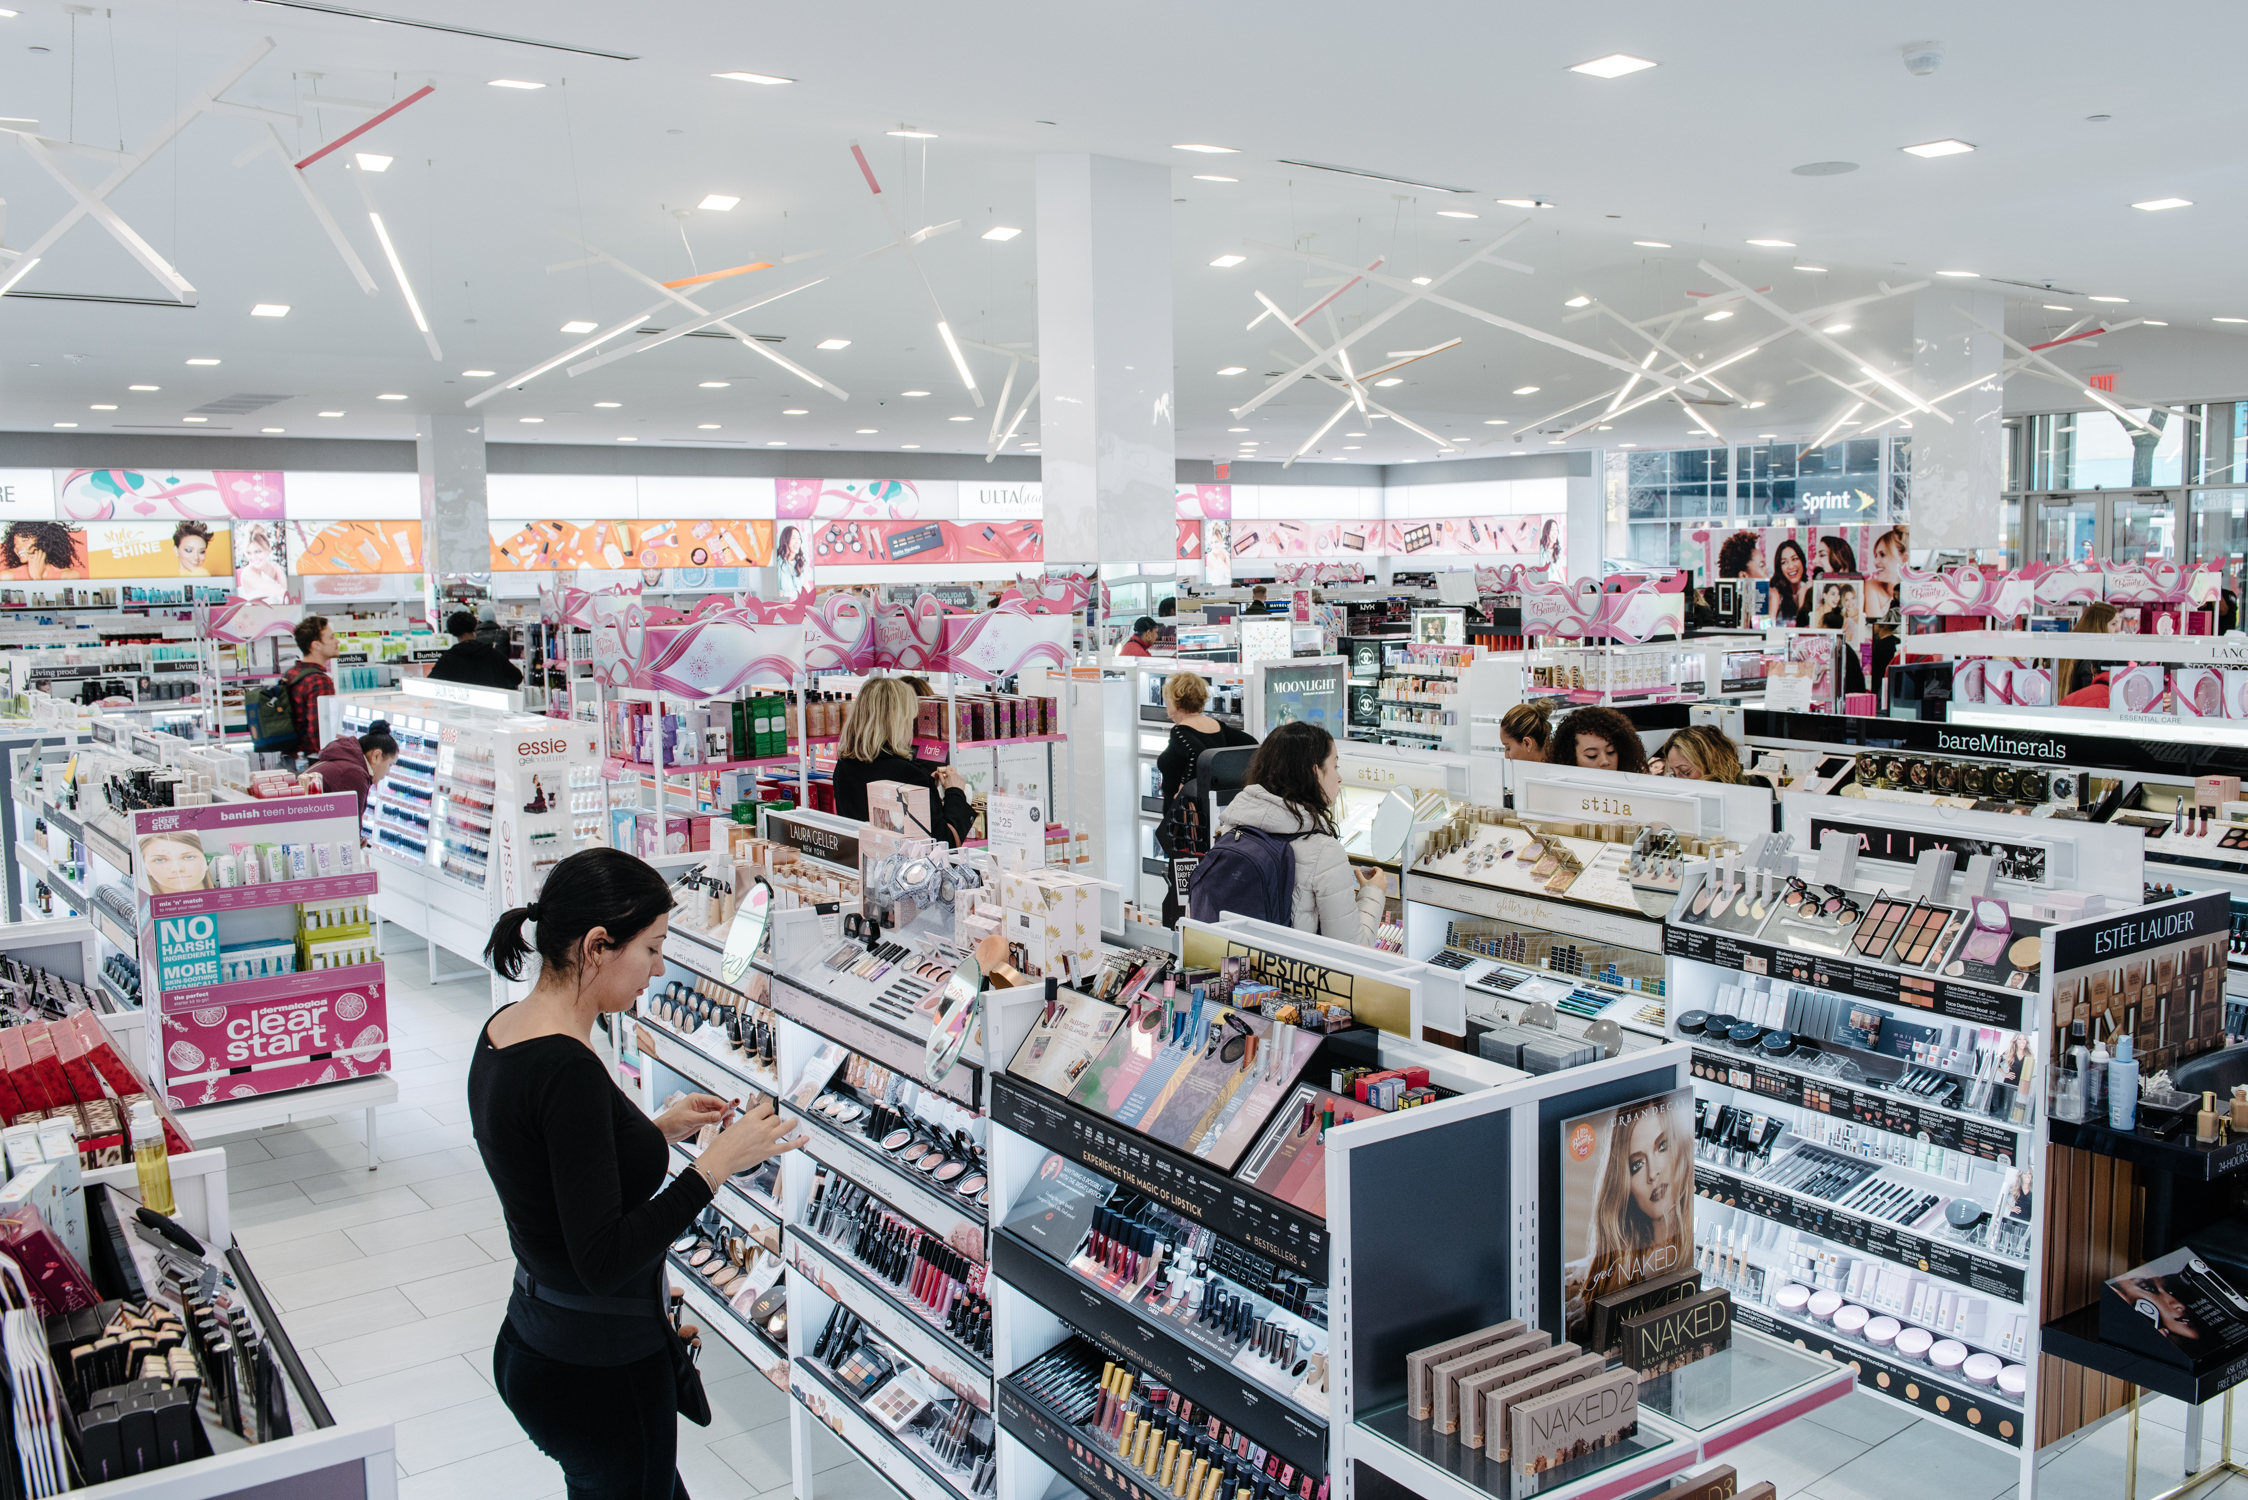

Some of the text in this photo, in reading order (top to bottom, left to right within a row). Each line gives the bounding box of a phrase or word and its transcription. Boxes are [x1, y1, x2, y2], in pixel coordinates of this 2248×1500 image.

[2090, 375, 2114, 392] EXIT
[1217, 465, 1228, 479] EXIT
[1802, 491, 1851, 514] Sprint
[104, 528, 143, 546] style
[112, 541, 162, 559] SHINE
[2114, 578, 2141, 590] Beauty
[1913, 586, 1941, 600] Beauty
[953, 598, 968, 606] HIM
[1533, 603, 1561, 617] Beauty
[882, 628, 907, 645] Beauty
[417, 651, 442, 659] Bumble
[31, 668, 79, 678] Living proof.
[175, 662, 197, 671] Living
[1273, 678, 1336, 693] MOONLIGHT
[2119, 715, 2158, 723] ESSENTIAL
[517, 738, 567, 755] essie
[924, 744, 941, 756] tarte
[1938, 731, 2067, 759] bareMinerals
[518, 753, 568, 766] gelcouture
[1358, 768, 1396, 783] stila
[220, 803, 335, 821] banish teen breakouts
[1581, 797, 1633, 817] stila
[152, 815, 180, 825] clear
[152, 822, 180, 831] start
[790, 824, 839, 851] LAURA GELLER
[1819, 828, 1949, 857] all
[813, 848, 826, 857] YORK
[1176, 864, 1184, 872] GO
[1496, 897, 1522, 917] glitter
[1530, 905, 1553, 923] glow
[160, 915, 214, 945] NO
[1009, 926, 1042, 940] NATURALLY GLAM
[2140, 910, 2195, 943] LAUDER
[162, 939, 215, 956] HARSH
[243, 951, 265, 960] Clearing
[163, 950, 216, 963] INGREDIENTS
[163, 961, 218, 980] MORE
[165, 974, 218, 986] SKIN-SOOTHING
[186, 991, 209, 999] perfect
[259, 997, 328, 1015] dermalogica
[226, 1006, 329, 1040] clear
[1069, 1018, 1090, 1030] PASSPORT
[1069, 1025, 1089, 1038] GLAMOUR
[226, 1024, 327, 1062] start
[1611, 1098, 1688, 1129] URBAN DECAY
[1576, 1124, 1589, 1138] Ulta
[1571, 1133, 1594, 1148] Beauty
[2218, 1153, 2245, 1173] 24-HOUR
[1083, 1150, 1122, 1177] EXPERIENCE
[1122, 1169, 1136, 1184] THE
[1137, 1177, 1159, 1197] MAGIC
[1159, 1188, 1170, 1201] OF
[1171, 1193, 1203, 1218] LIPSTICK
[1254, 1235, 1298, 1265] BESTSELLERS
[1932, 1243, 1969, 1259] Glowing Goddess
[1586, 1244, 1678, 1291] get NAKED
[1971, 1256, 1982, 1264] Eyes
[1147, 1307, 1159, 1317] CHESS
[1149, 1301, 1164, 1313] LIPSTICK
[1641, 1299, 1727, 1358] NAKED
[1100, 1330, 1172, 1382] CROWN WORTHY LIP LOOKS
[1416, 1339, 1461, 1357] URBAN DECAY
[1642, 1344, 1688, 1366] URBAN DECAY
[1442, 1352, 1486, 1369] URBAN DECAY
[2226, 1358, 2248, 1375] ASK FOR
[1468, 1364, 1514, 1382] URBAN DECAY
[1496, 1377, 1541, 1396] URBAN DECAY
[2217, 1376, 2230, 1391] FREE
[1247, 1392, 1258, 1402] METALS
[1522, 1390, 1569, 1409] URBAN DECAY
[1531, 1430, 1583, 1455] URBAN DECAY
[1083, 1474, 1100, 1489] BESPOKE
